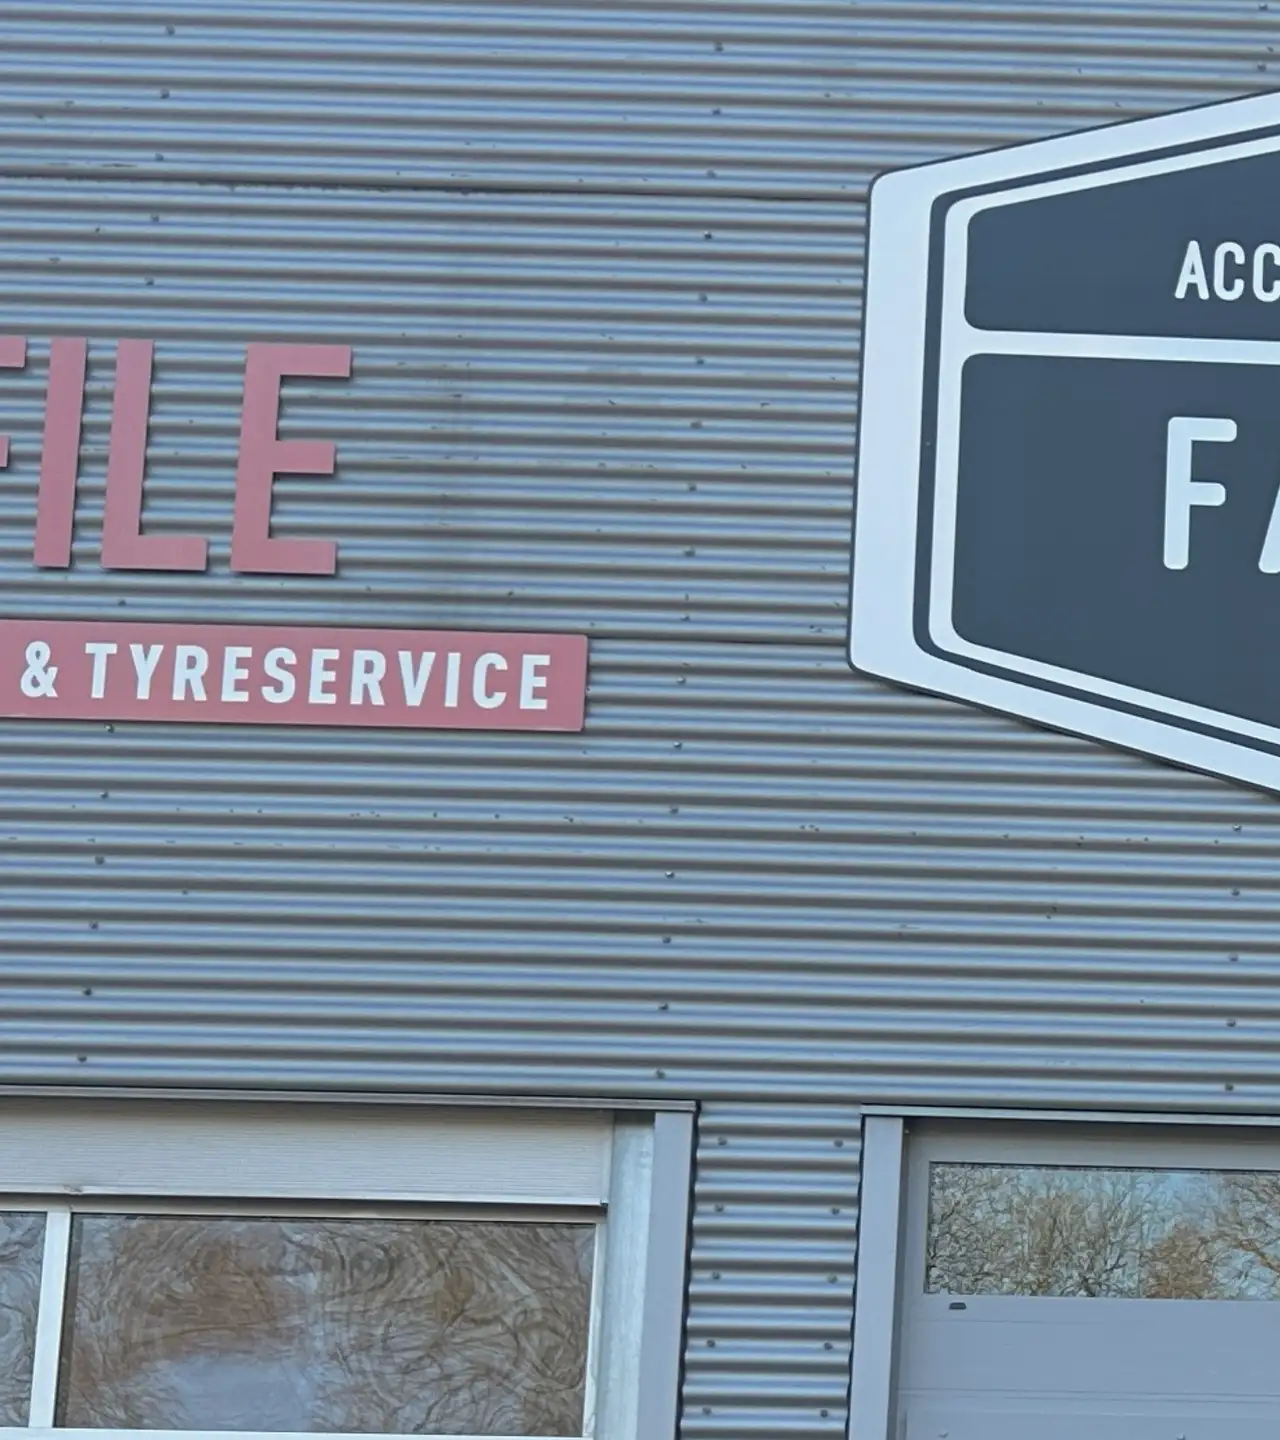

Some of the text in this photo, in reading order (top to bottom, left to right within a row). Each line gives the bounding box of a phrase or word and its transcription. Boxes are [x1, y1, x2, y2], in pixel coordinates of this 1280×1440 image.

[0, 335, 353, 576] ILE
[19, 641, 551, 710] & TYRESERVICE
